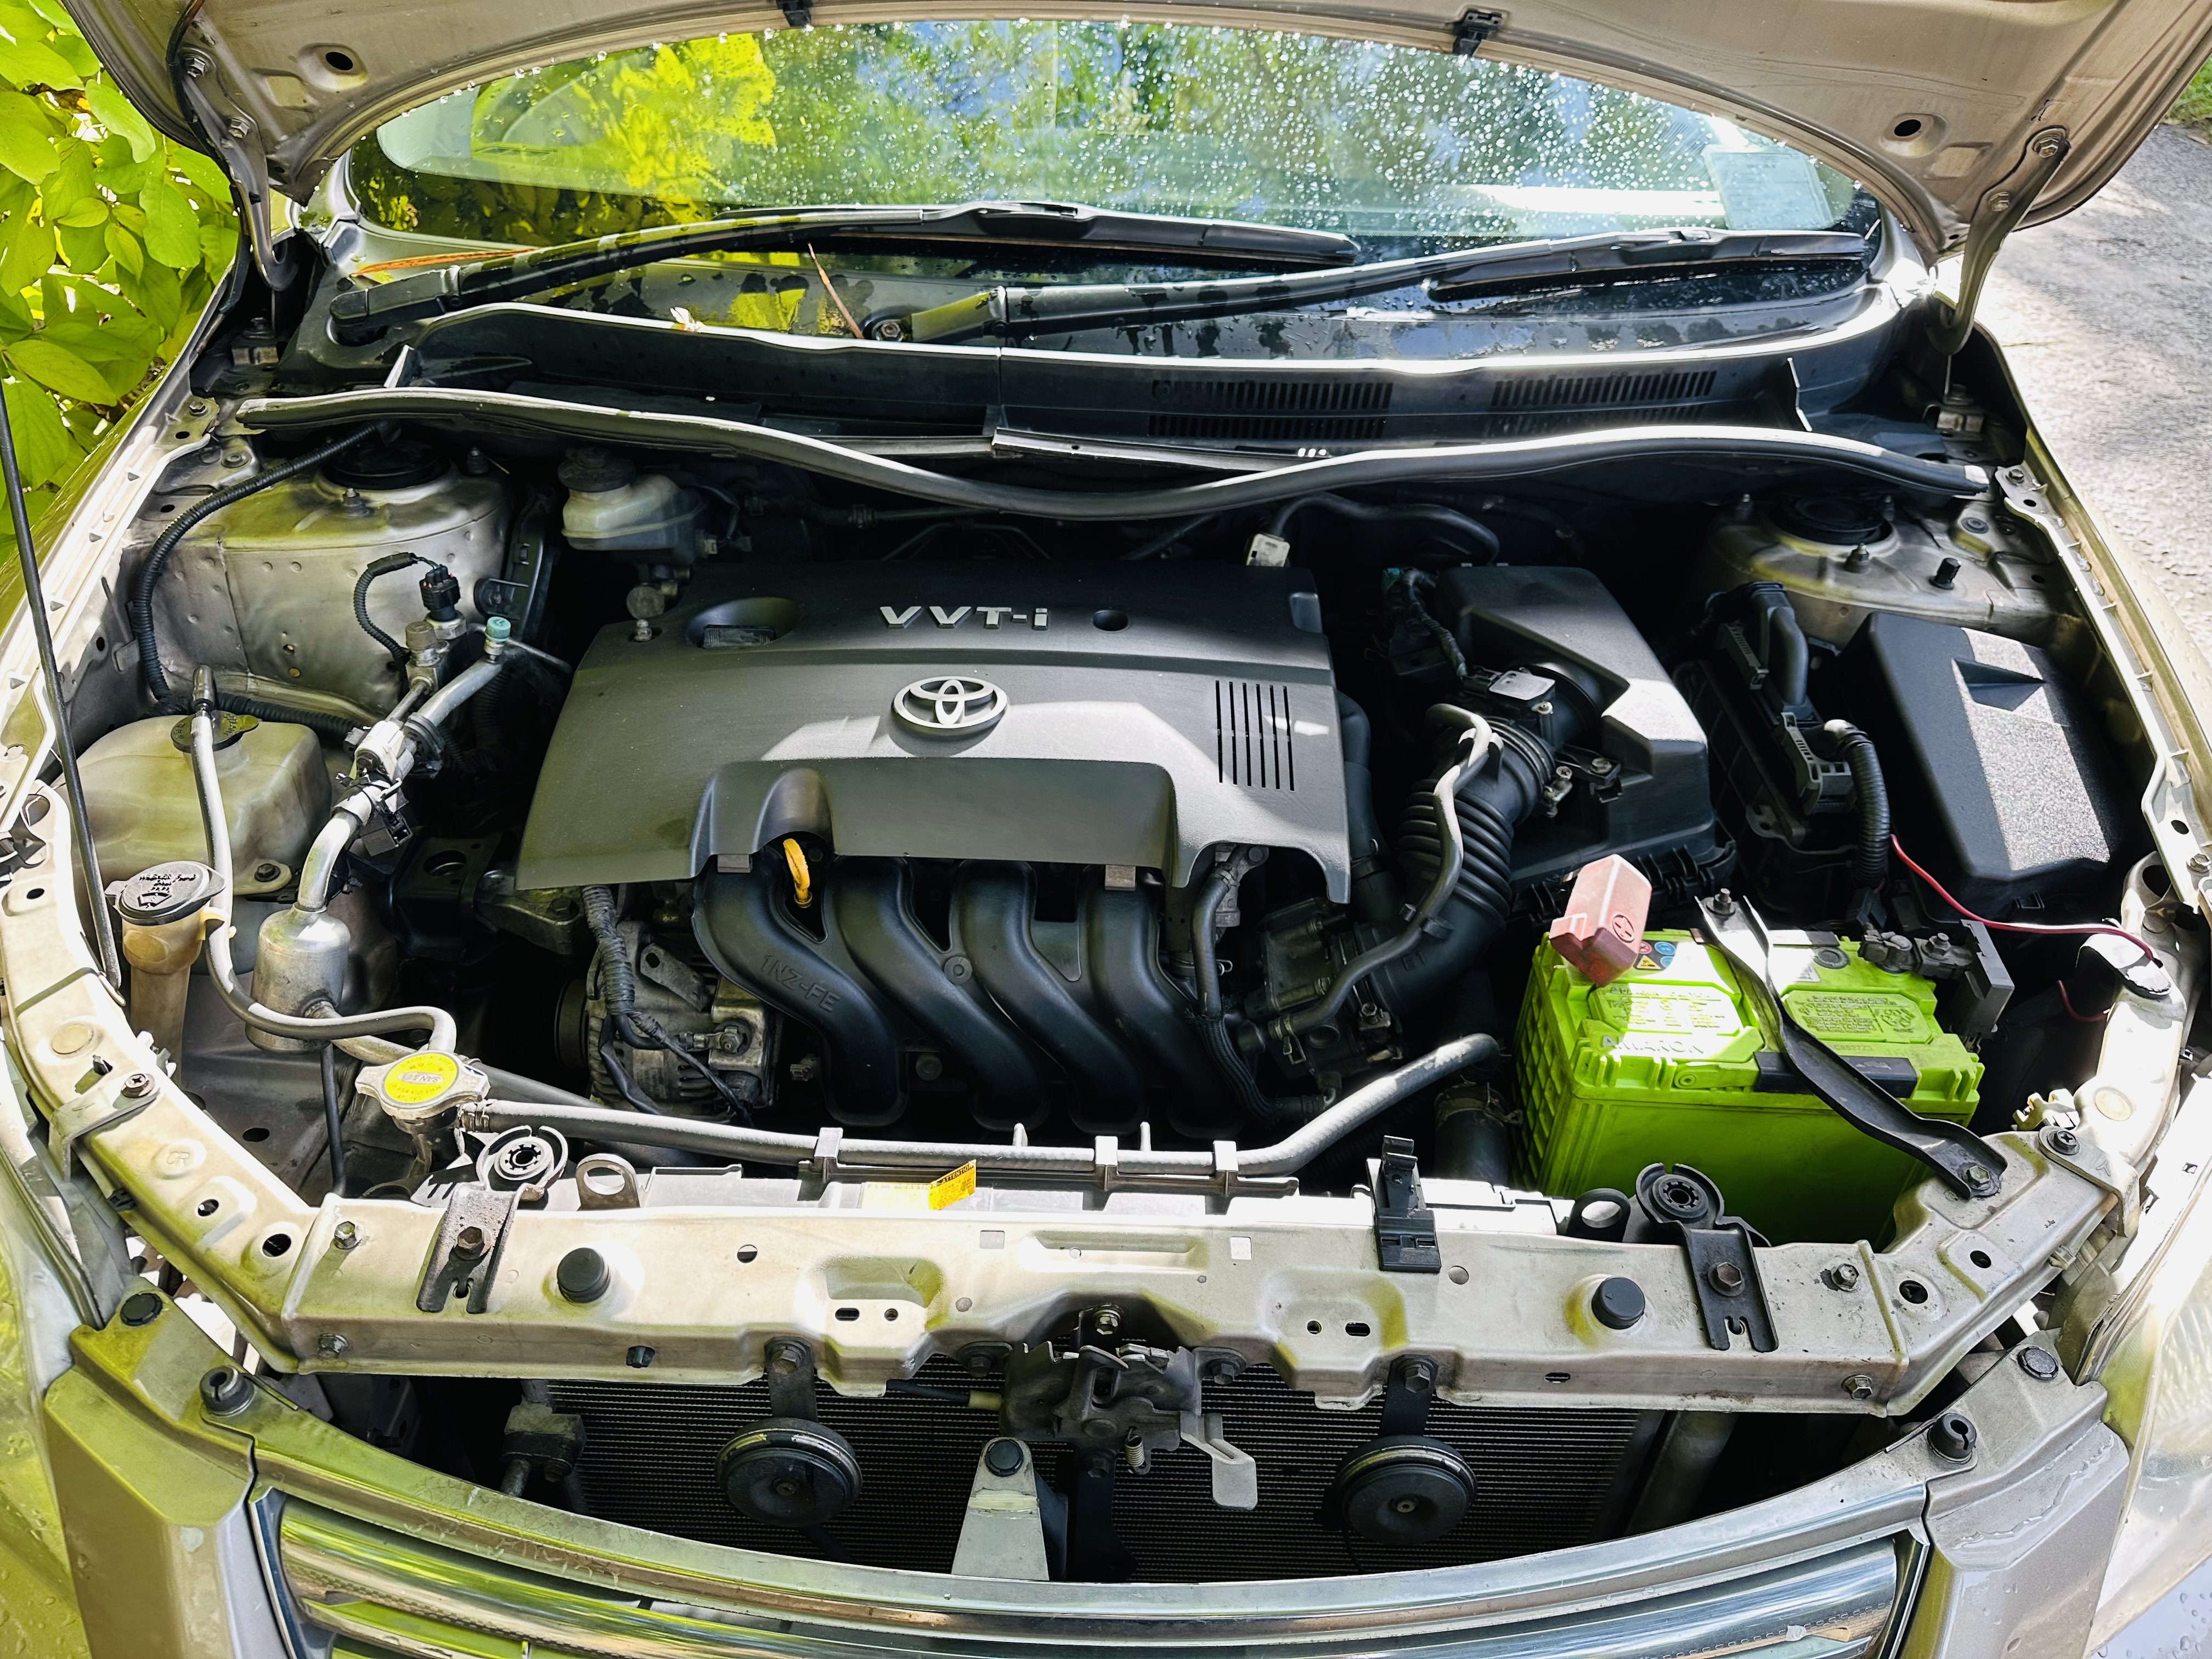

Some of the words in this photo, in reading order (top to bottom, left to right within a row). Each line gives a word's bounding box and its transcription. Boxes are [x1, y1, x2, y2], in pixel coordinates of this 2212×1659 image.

[879, 606, 1048, 630] VVT-i
[760, 954, 841, 1013] 1NZ-FE
[941, 1163, 974, 1185] ATTENTION
